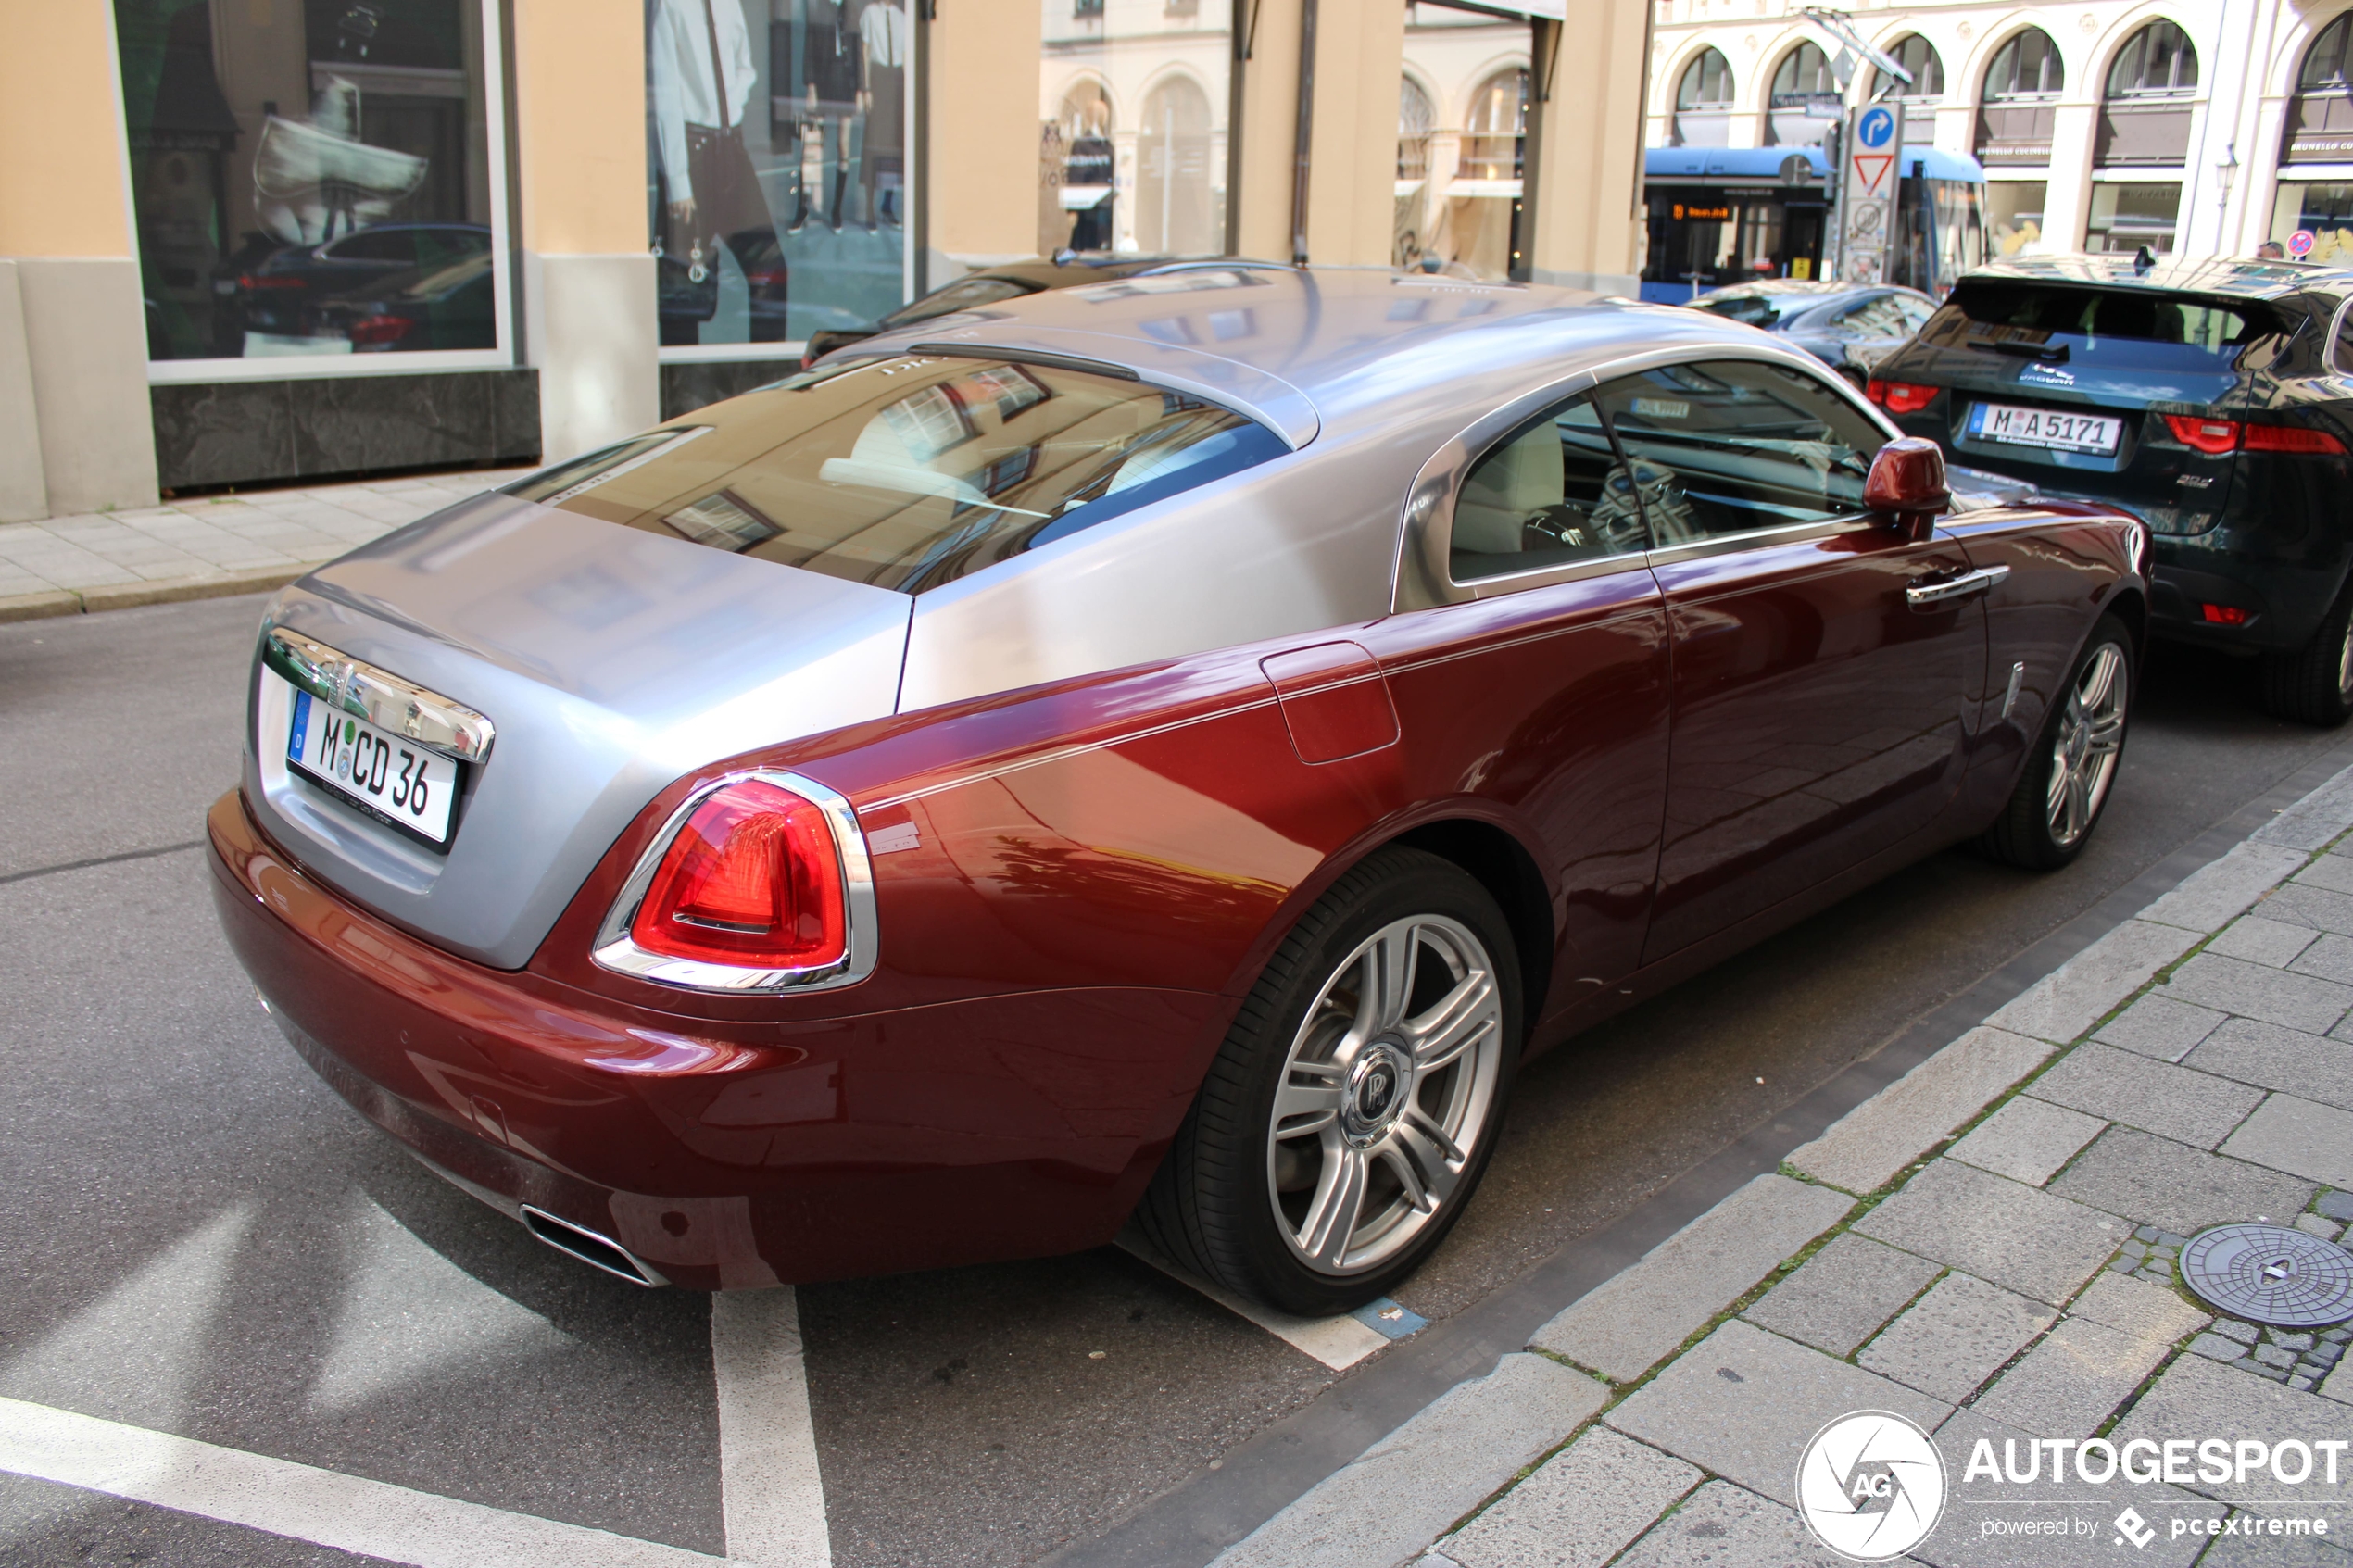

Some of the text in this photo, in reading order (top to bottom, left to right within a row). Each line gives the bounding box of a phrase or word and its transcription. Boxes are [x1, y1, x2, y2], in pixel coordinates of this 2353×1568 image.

[2290, 143, 2337, 152] BRUNELLO
[2019, 374, 2075, 386] JAGUAR
[1994, 409, 2011, 432] M
[2025, 414, 2039, 436] A
[2045, 416, 2106, 444] 5171
[295, 712, 429, 816] D M CD 36
